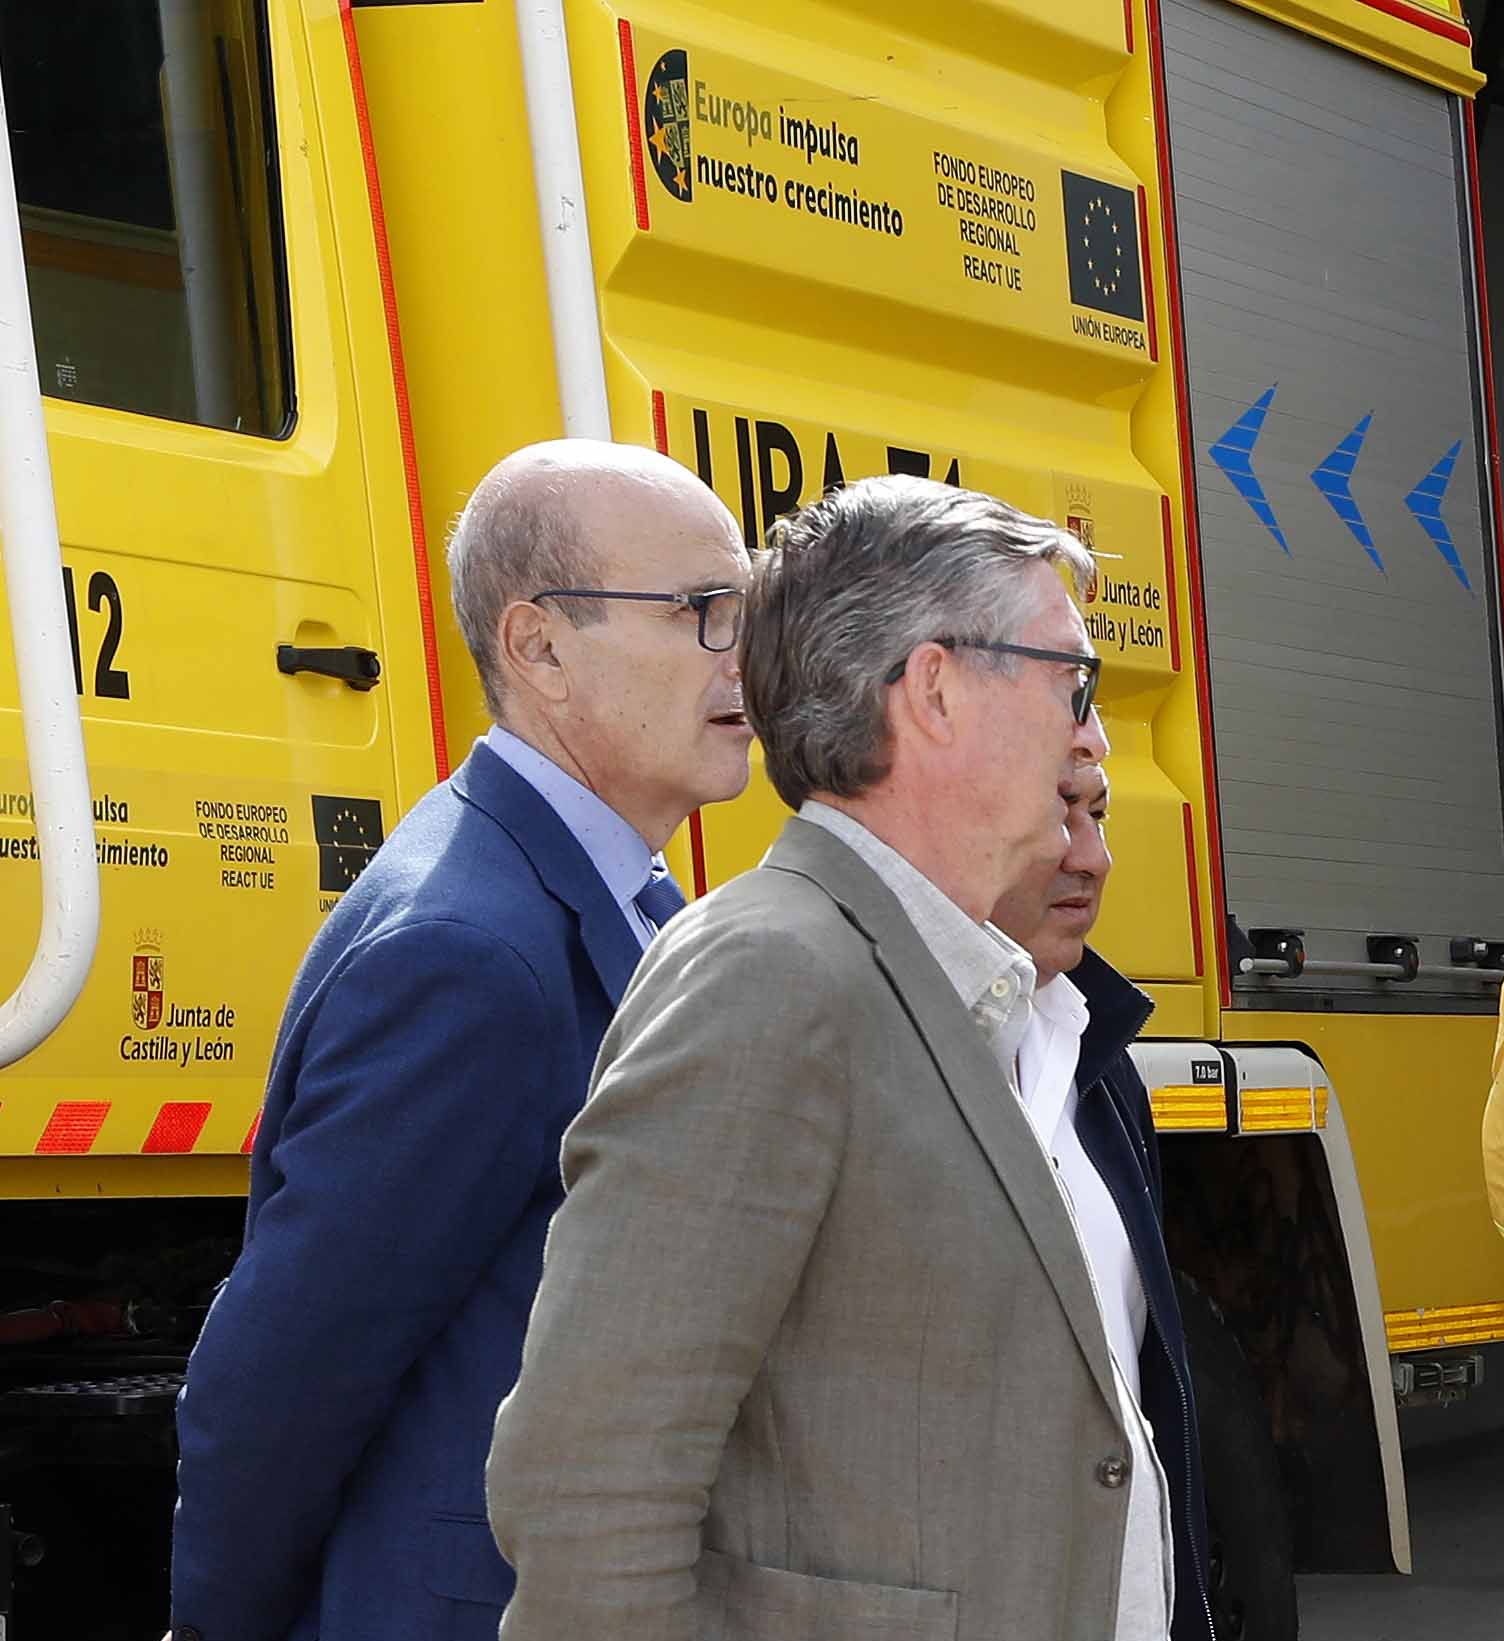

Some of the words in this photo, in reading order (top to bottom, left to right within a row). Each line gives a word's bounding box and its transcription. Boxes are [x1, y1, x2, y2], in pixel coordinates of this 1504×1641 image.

[695, 79, 772, 148] Europa
[779, 105, 859, 167] impulsa
[933, 151, 976, 185] FONDO
[978, 164, 1035, 203] EUROPEO
[697, 154, 778, 204] nuestro
[785, 182, 903, 237] crecimiento
[937, 182, 954, 209] DE
[957, 188, 1036, 232] DESARROLLO
[959, 218, 1021, 256] REGIONAL
[963, 254, 1003, 285] REACT
[1005, 265, 1022, 291] UE
[1072, 314, 1101, 339] UNIÓN
[1103, 323, 1146, 350] EUROPEA
[1102, 574, 1140, 607] Junta
[1143, 582, 1160, 610] de
[1084, 611, 1116, 641] stilla
[1117, 622, 1127, 652] y
[1129, 617, 1164, 648] León
[196, 801, 234, 818] FONDO
[236, 804, 288, 823] EUROPEO
[199, 822, 214, 838] DE
[216, 824, 289, 844] DESARROLLO
[220, 844, 276, 864] REGIONAL
[221, 870, 257, 888] REACT
[260, 873, 275, 889] UE
[166, 1003, 211, 1028] Junta
[215, 1003, 235, 1028] de
[120, 1036, 178, 1061] Castilla
[180, 1042, 192, 1068] y
[195, 1036, 234, 1061] León
